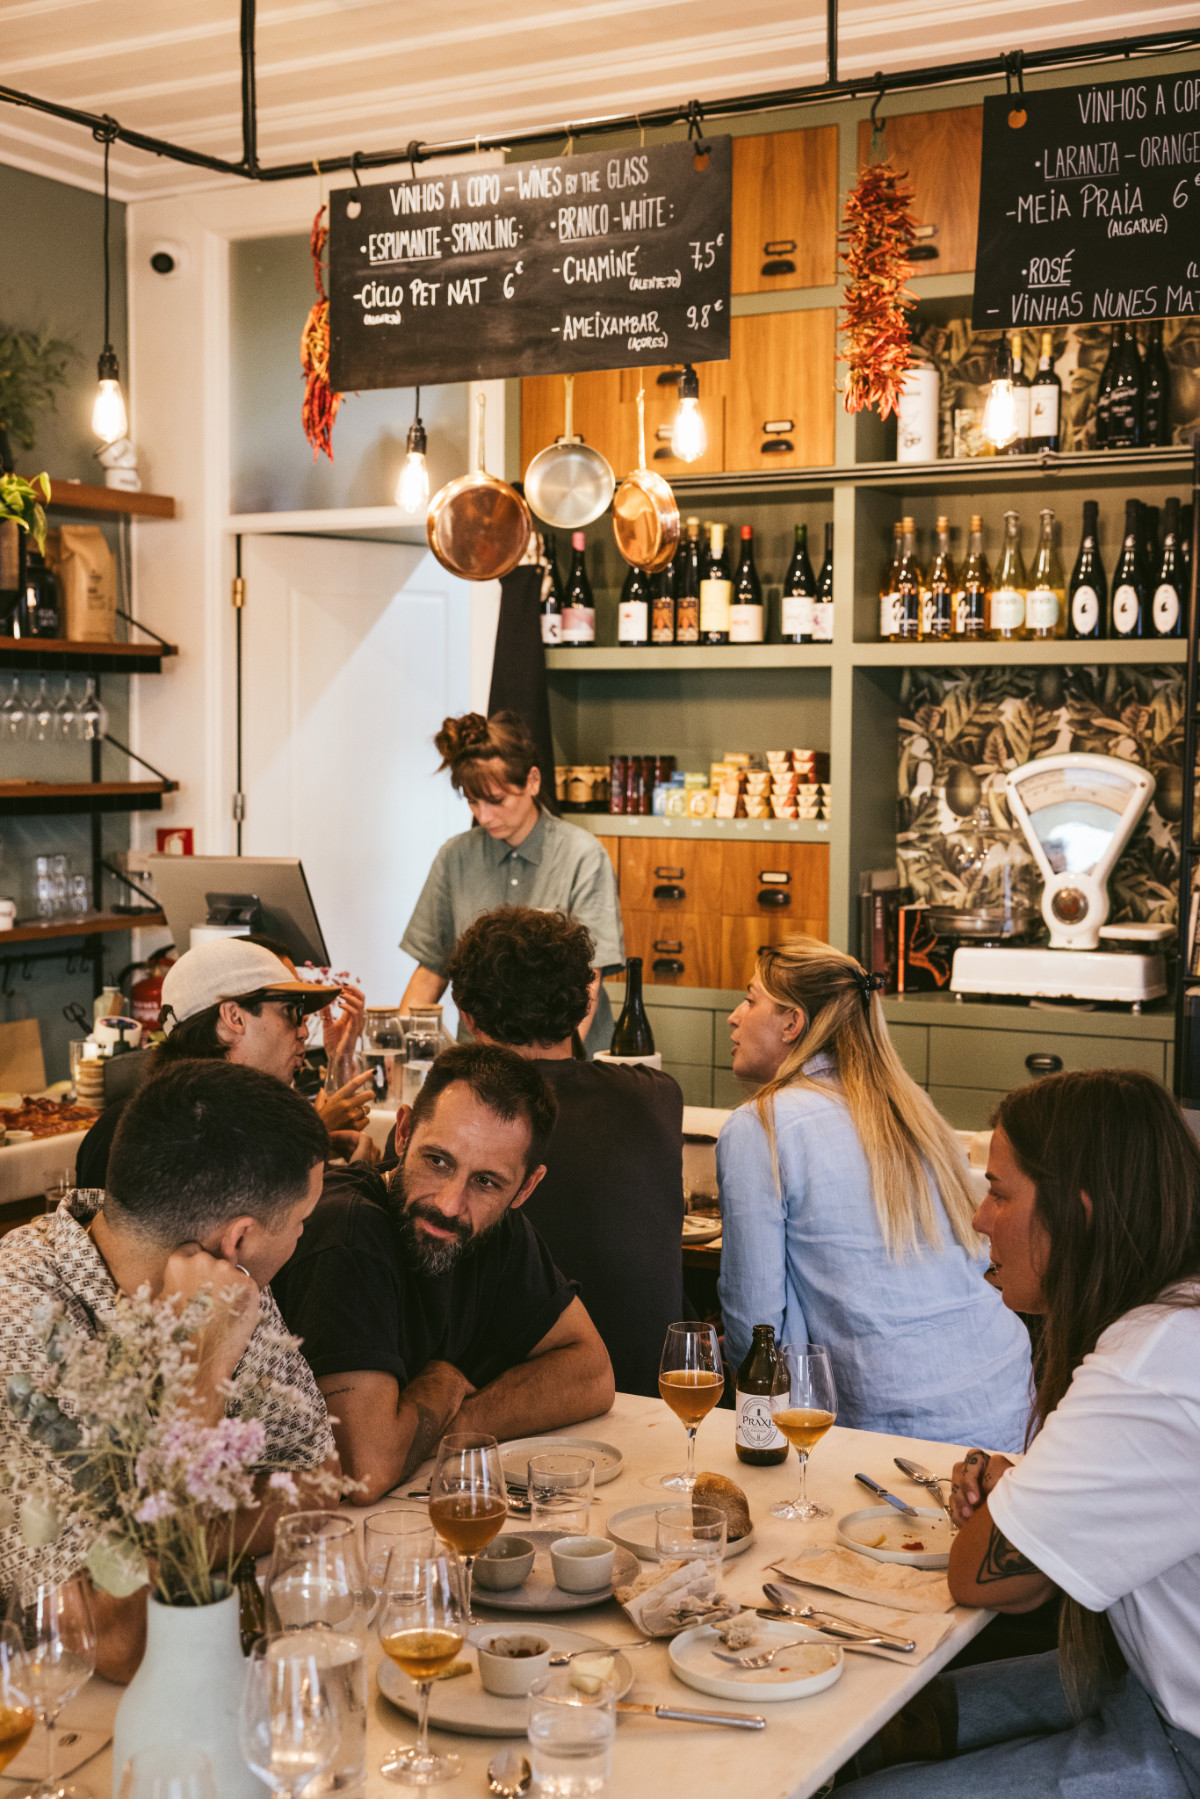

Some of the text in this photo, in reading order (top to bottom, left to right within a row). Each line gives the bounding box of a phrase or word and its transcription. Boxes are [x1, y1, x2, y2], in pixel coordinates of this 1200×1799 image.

[1078, 85, 1147, 124] VINHOS
[1155, 83, 1166, 115] A
[1044, 141, 1120, 180] LARANJA
[1140, 131, 1200, 168] ORANGE
[389, 182, 445, 216] VINHOS
[450, 180, 460, 209] A
[467, 174, 500, 208] COPO
[518, 165, 562, 200] WINES
[565, 174, 578, 195] BY
[580, 170, 602, 193] THE
[607, 155, 650, 189] GLASS
[1080, 182, 1143, 218] PRAIA
[558, 203, 609, 240] BRANCO
[1107, 213, 1168, 239] (ALGARVE)
[368, 226, 442, 261] ESPUMANTE
[688, 233, 725, 272] 7,5€
[409, 278, 442, 306] PET
[447, 276, 488, 306] NAT
[503, 260, 524, 299] 6€
[629, 269, 682, 291] (ALENTEJO)
[1028, 248, 1076, 284] ROSÉ
[686, 299, 724, 331] 9,8€
[1011, 291, 1084, 324] VINHAS
[1092, 285, 1159, 319] NUNES
[627, 331, 669, 352] (AÇORES)
